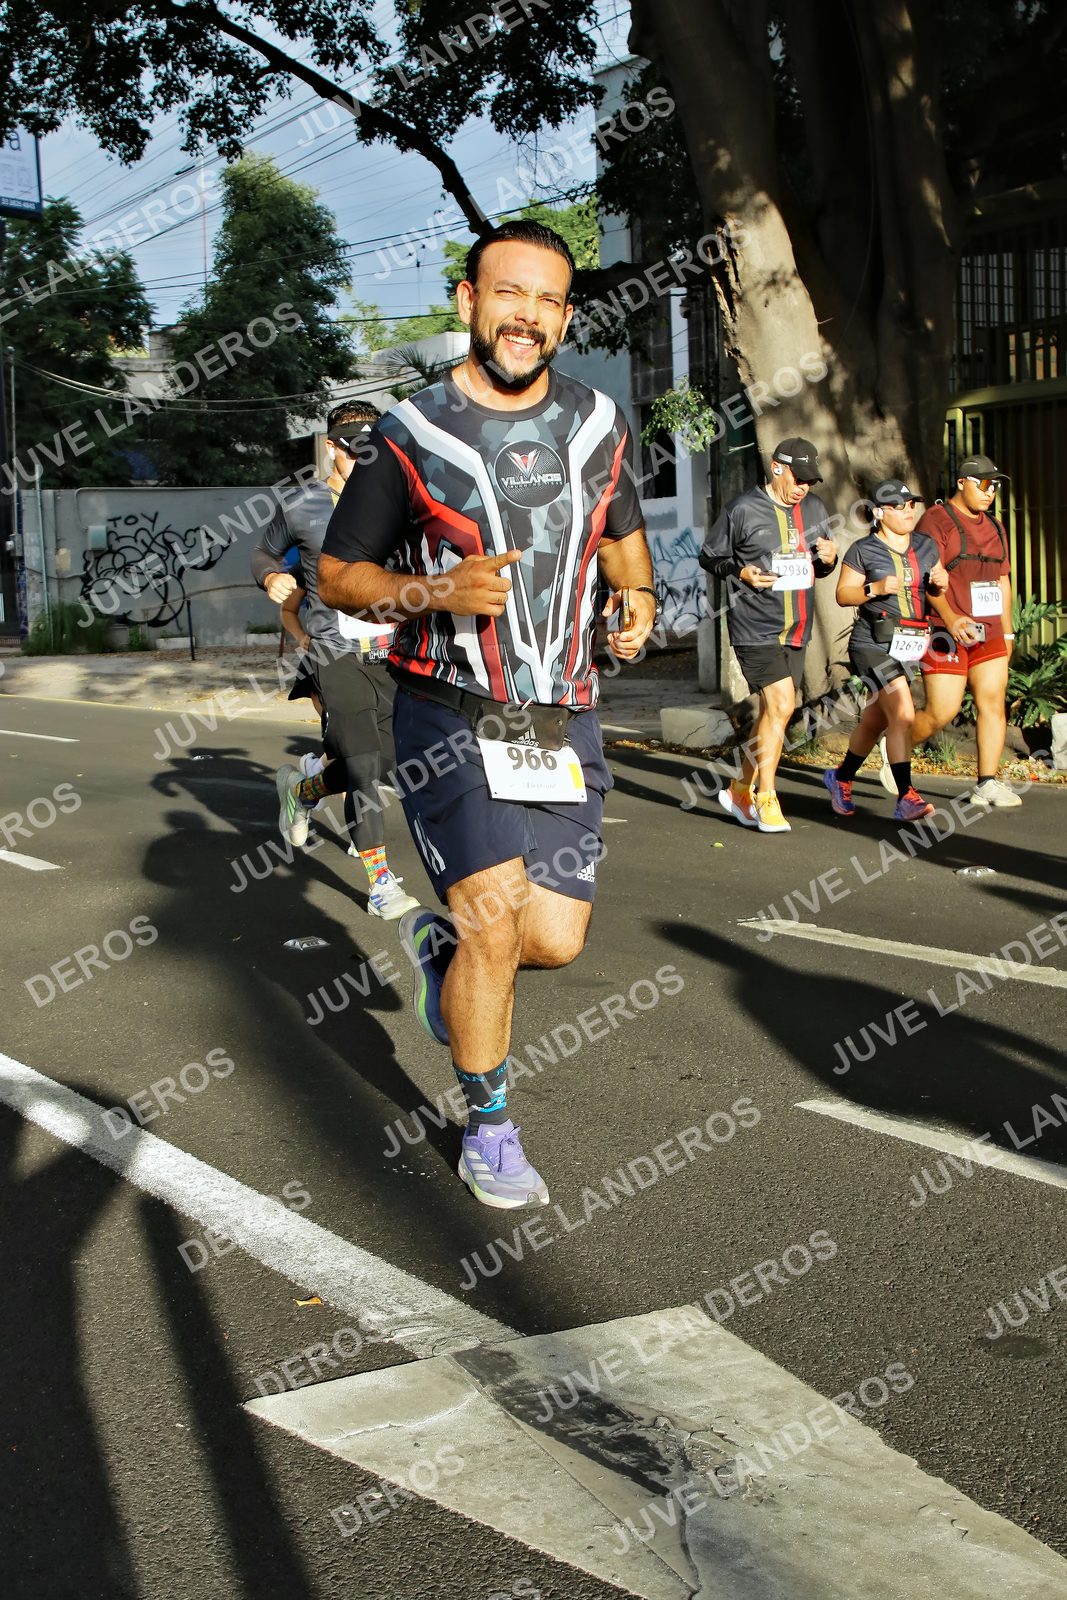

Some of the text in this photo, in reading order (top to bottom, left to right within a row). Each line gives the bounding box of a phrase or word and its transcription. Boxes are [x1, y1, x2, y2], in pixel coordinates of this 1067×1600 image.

[107, 511, 159, 531] TOY
[776, 564, 809, 576] 12936
[978, 591, 1000, 603] 9670
[895, 640, 923, 651] 12676
[506, 746, 558, 771] 966
